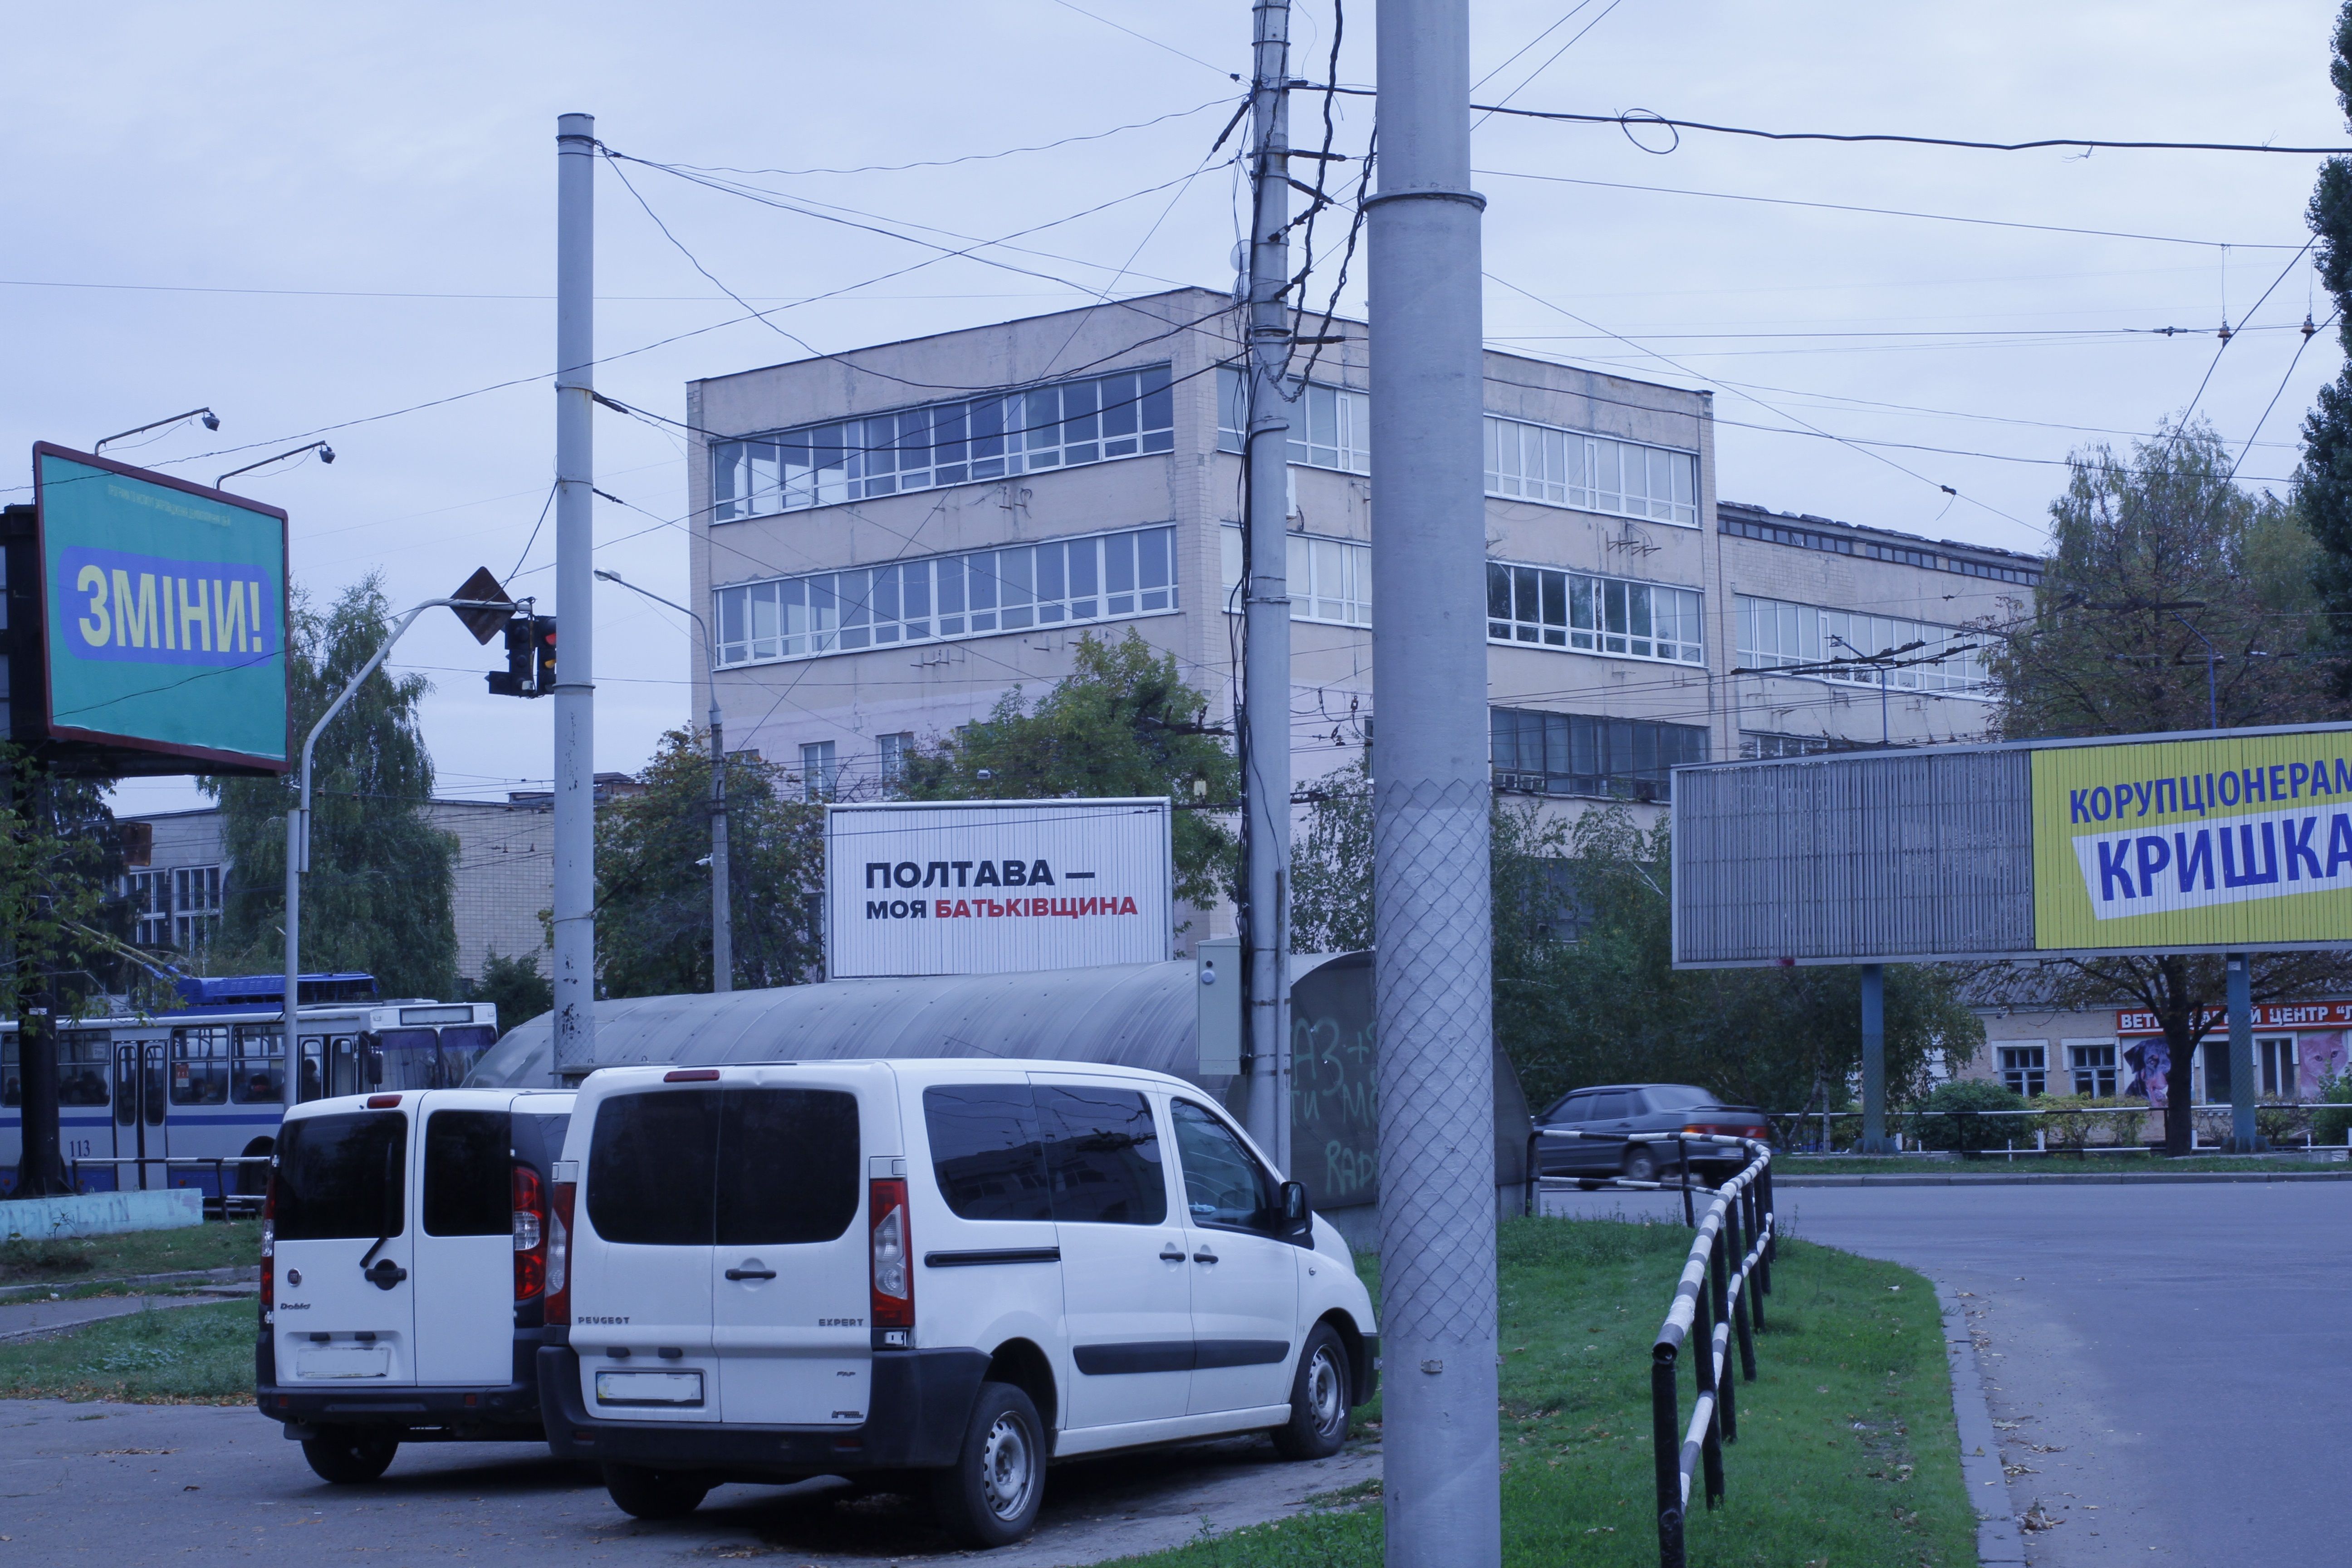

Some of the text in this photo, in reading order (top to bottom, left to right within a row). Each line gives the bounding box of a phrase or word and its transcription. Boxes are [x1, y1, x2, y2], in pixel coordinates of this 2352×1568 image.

[78, 565, 262, 652] ЗМІНИ!
[2098, 813, 2352, 901] КРИШКА
[866, 860, 1055, 888] ПОЛТАВА
[867, 897, 1138, 919] МОЯ БАТЬКІВЩИНА
[2269, 1006, 2328, 1025] ЦЕНТР
[70, 1140, 90, 1157] 113
[1324, 1140, 1379, 1195] RAD
